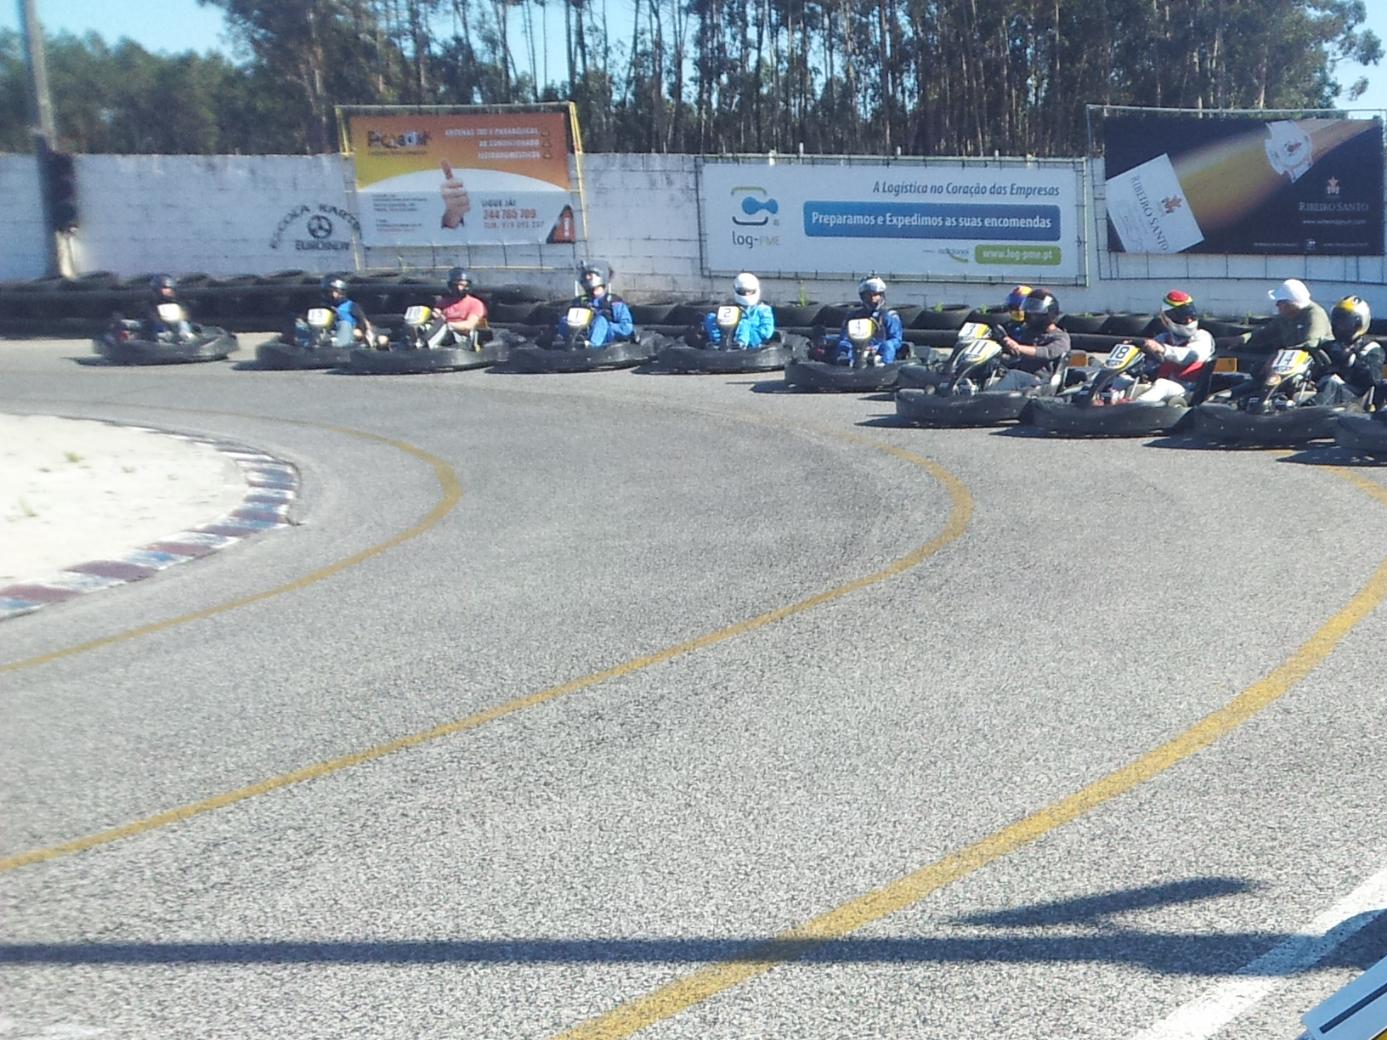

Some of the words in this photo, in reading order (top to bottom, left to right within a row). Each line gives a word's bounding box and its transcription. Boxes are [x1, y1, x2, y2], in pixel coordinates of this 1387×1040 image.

[873, 182, 880, 193] A
[930, 186, 944, 194] no
[946, 182, 987, 198] Coração
[989, 183, 1007, 196] das
[1010, 183, 1060, 199] Empresas
[812, 212, 875, 227] Preparamos
[877, 215, 883, 225] e
[886, 213, 943, 228] Expedimos
[945, 217, 956, 226] as
[959, 217, 982, 227] suas
[984, 215, 1052, 229] encomendas
[1130, 175, 1153, 217] RIBEIRO
[1149, 217, 1169, 251] SANTO
[723, 308, 732, 318] 2
[1111, 345, 1130, 358] 18
